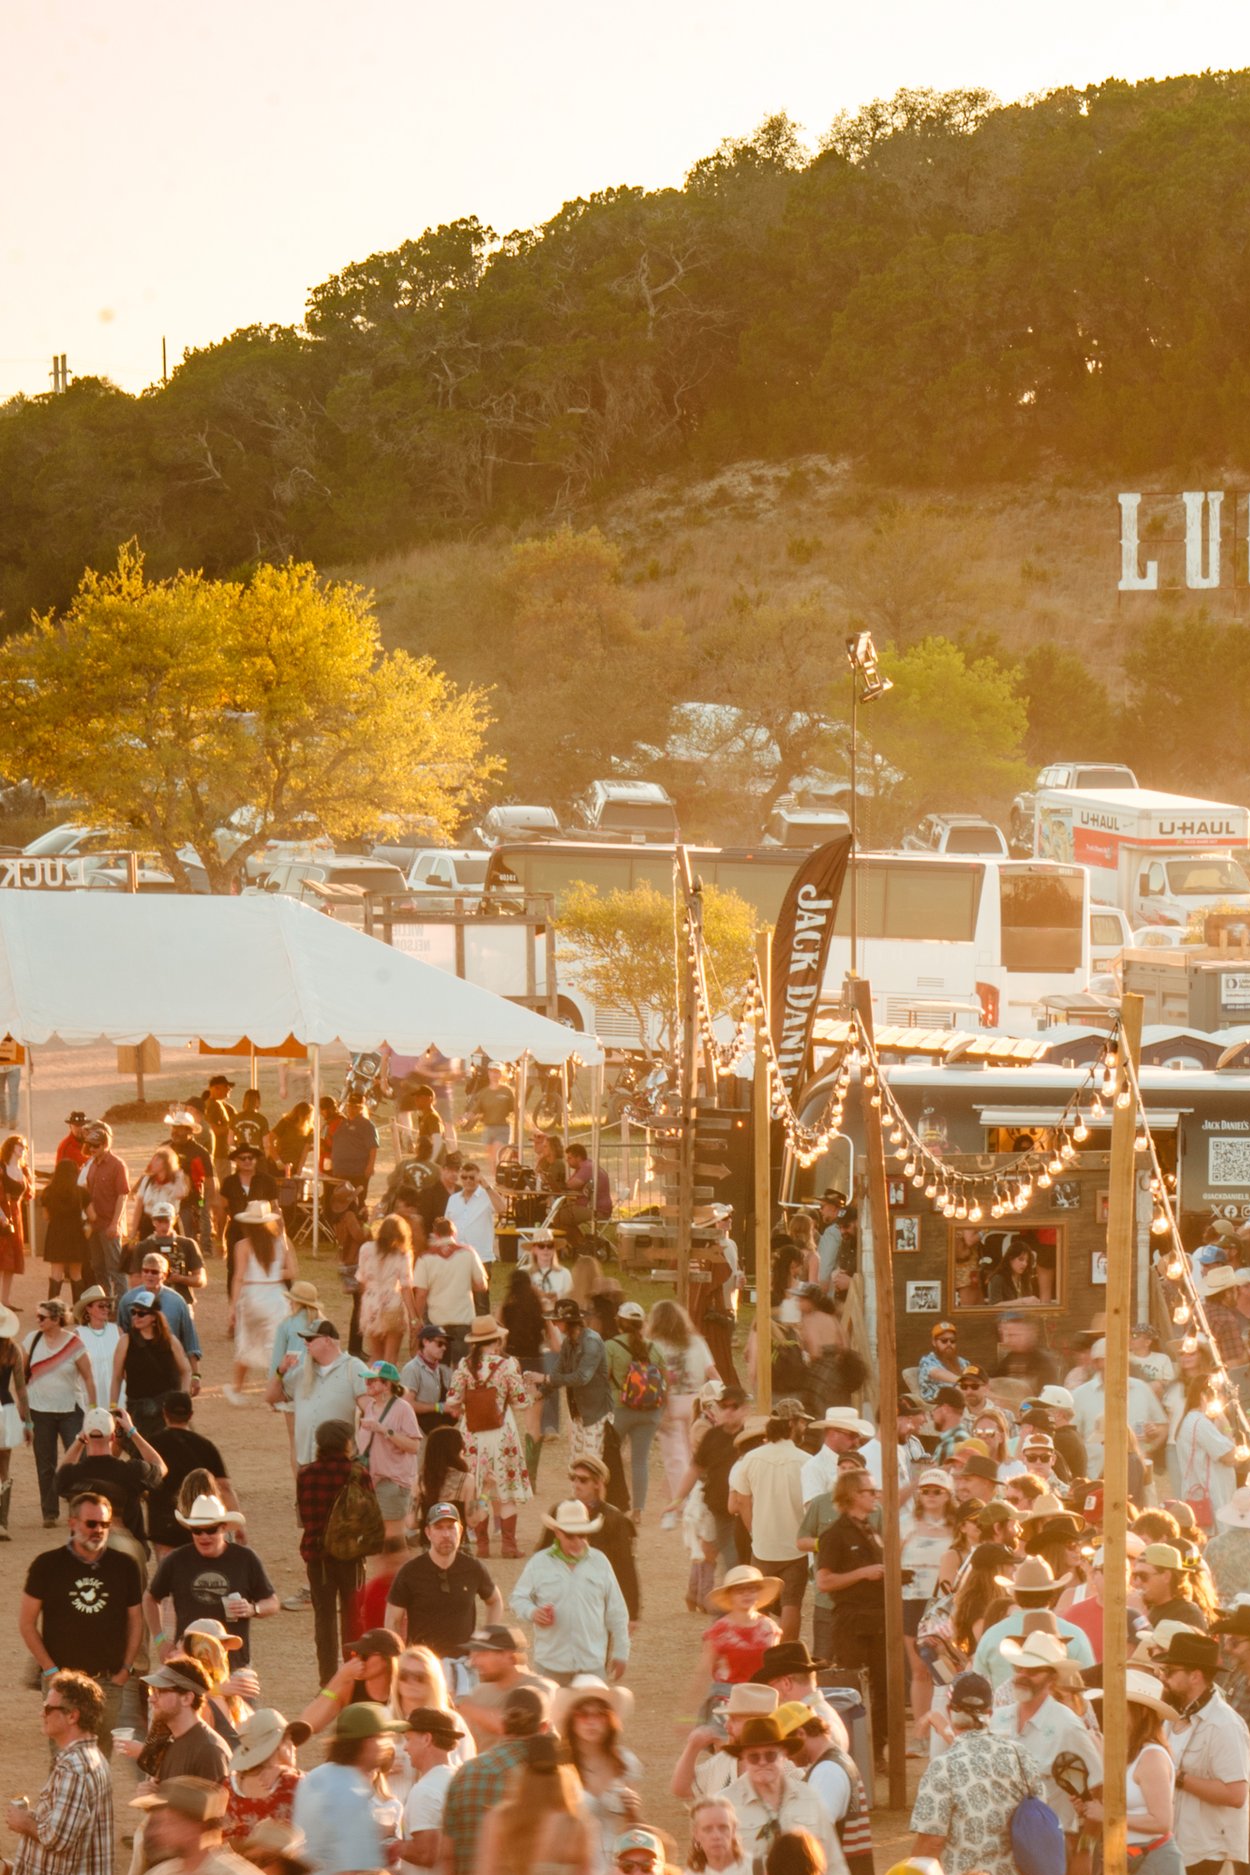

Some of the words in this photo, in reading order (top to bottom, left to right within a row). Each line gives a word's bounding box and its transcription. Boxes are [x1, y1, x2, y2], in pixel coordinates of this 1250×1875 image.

[788, 883, 833, 975] JACK
[1202, 1119, 1220, 1130] JACK
[1220, 1119, 1249, 1130] DANIEL'S
[74, 1576, 105, 1589] MUSIC
